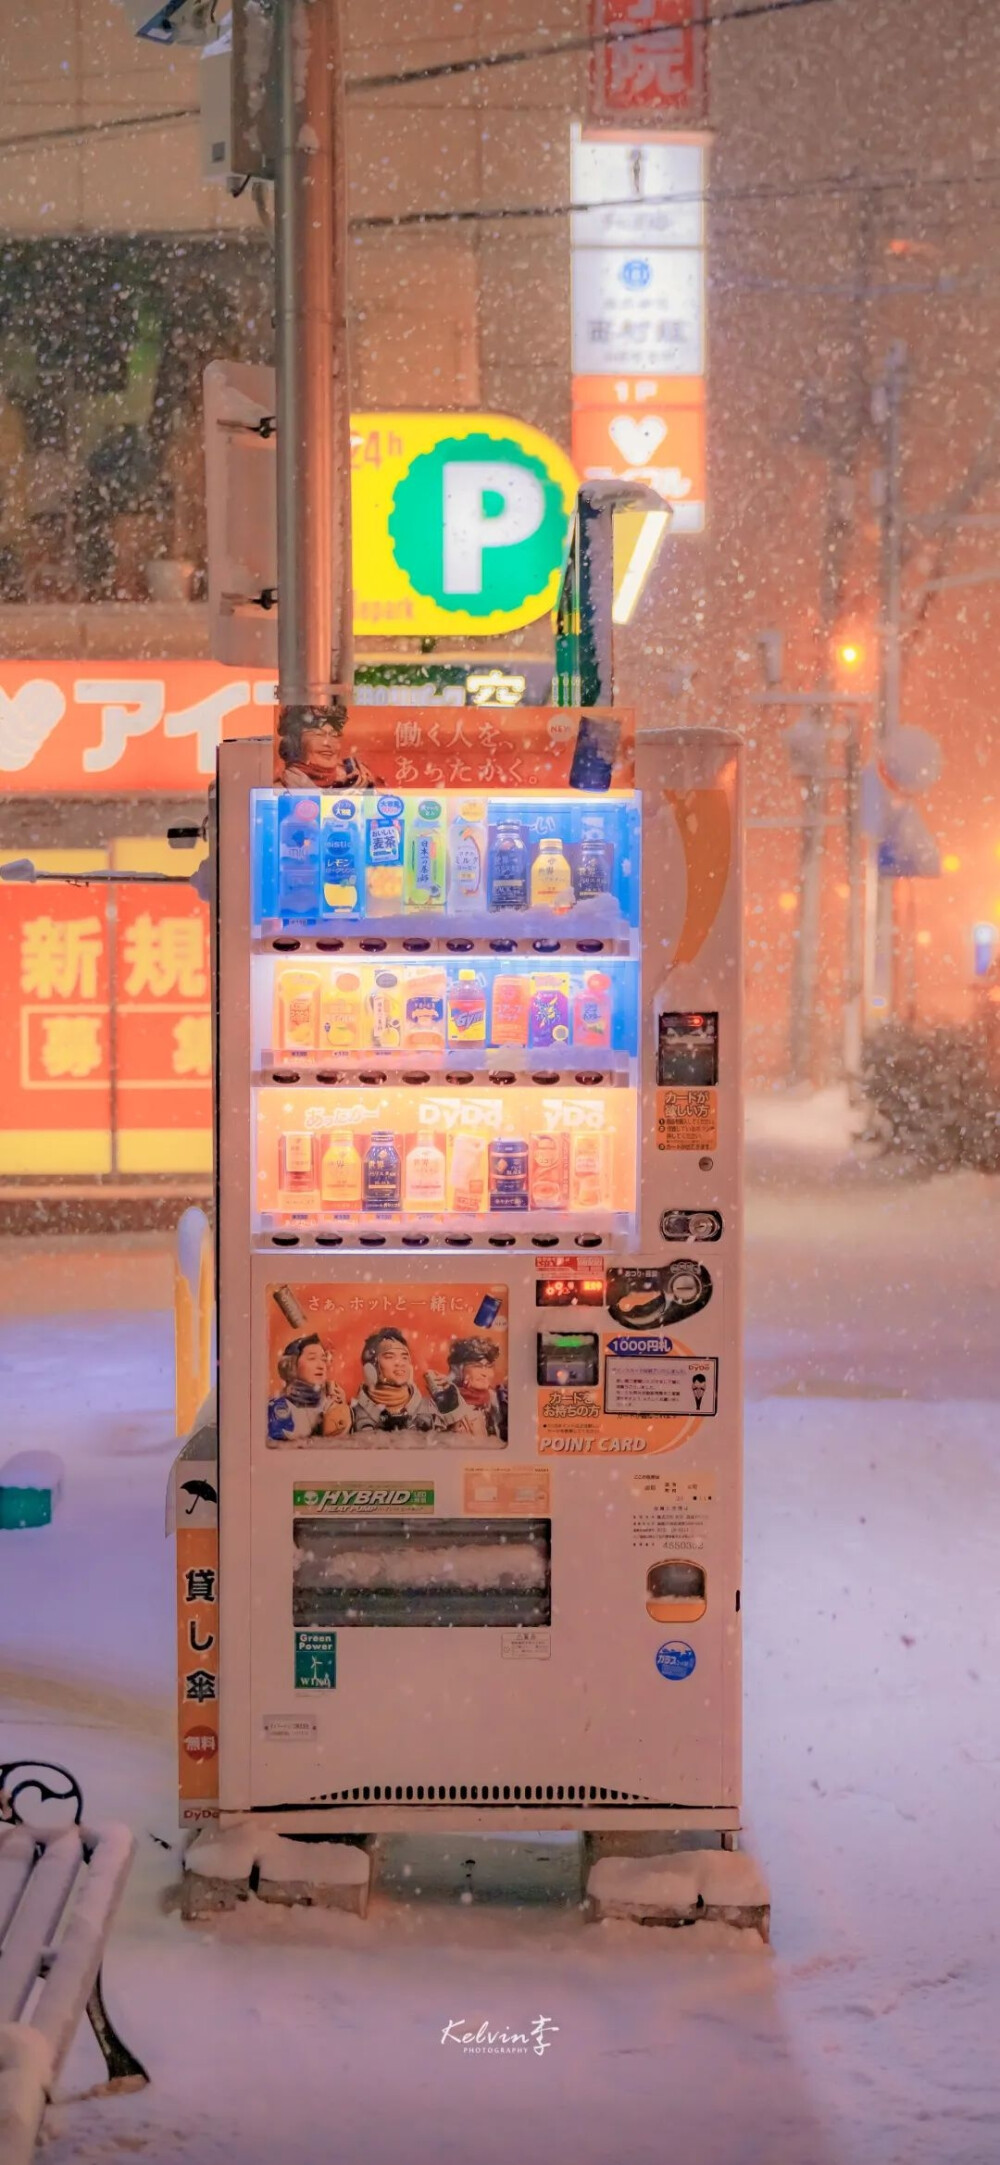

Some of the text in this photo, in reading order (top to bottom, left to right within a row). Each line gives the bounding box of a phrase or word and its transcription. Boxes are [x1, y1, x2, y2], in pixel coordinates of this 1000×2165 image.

[442, 460, 546, 594] P
[74, 679, 278, 774] アイ
[394, 719, 514, 749] 働く人を、
[372, 835, 397, 851] 麦茶
[664, 1091, 709, 1104] カードが
[664, 1104, 709, 1117] 欲しい方
[611, 1339, 671, 1352] 1000円札
[543, 1404, 600, 1418] お持ちの方
[539, 1437, 647, 1452] POINT CARD
[317, 1490, 412, 1510] HYBRID
[184, 1569, 217, 1703] 貸し傘
[299, 1633, 332, 1642] Green
[298, 1642, 333, 1650] Power
[183, 1734, 216, 1752] 無料
